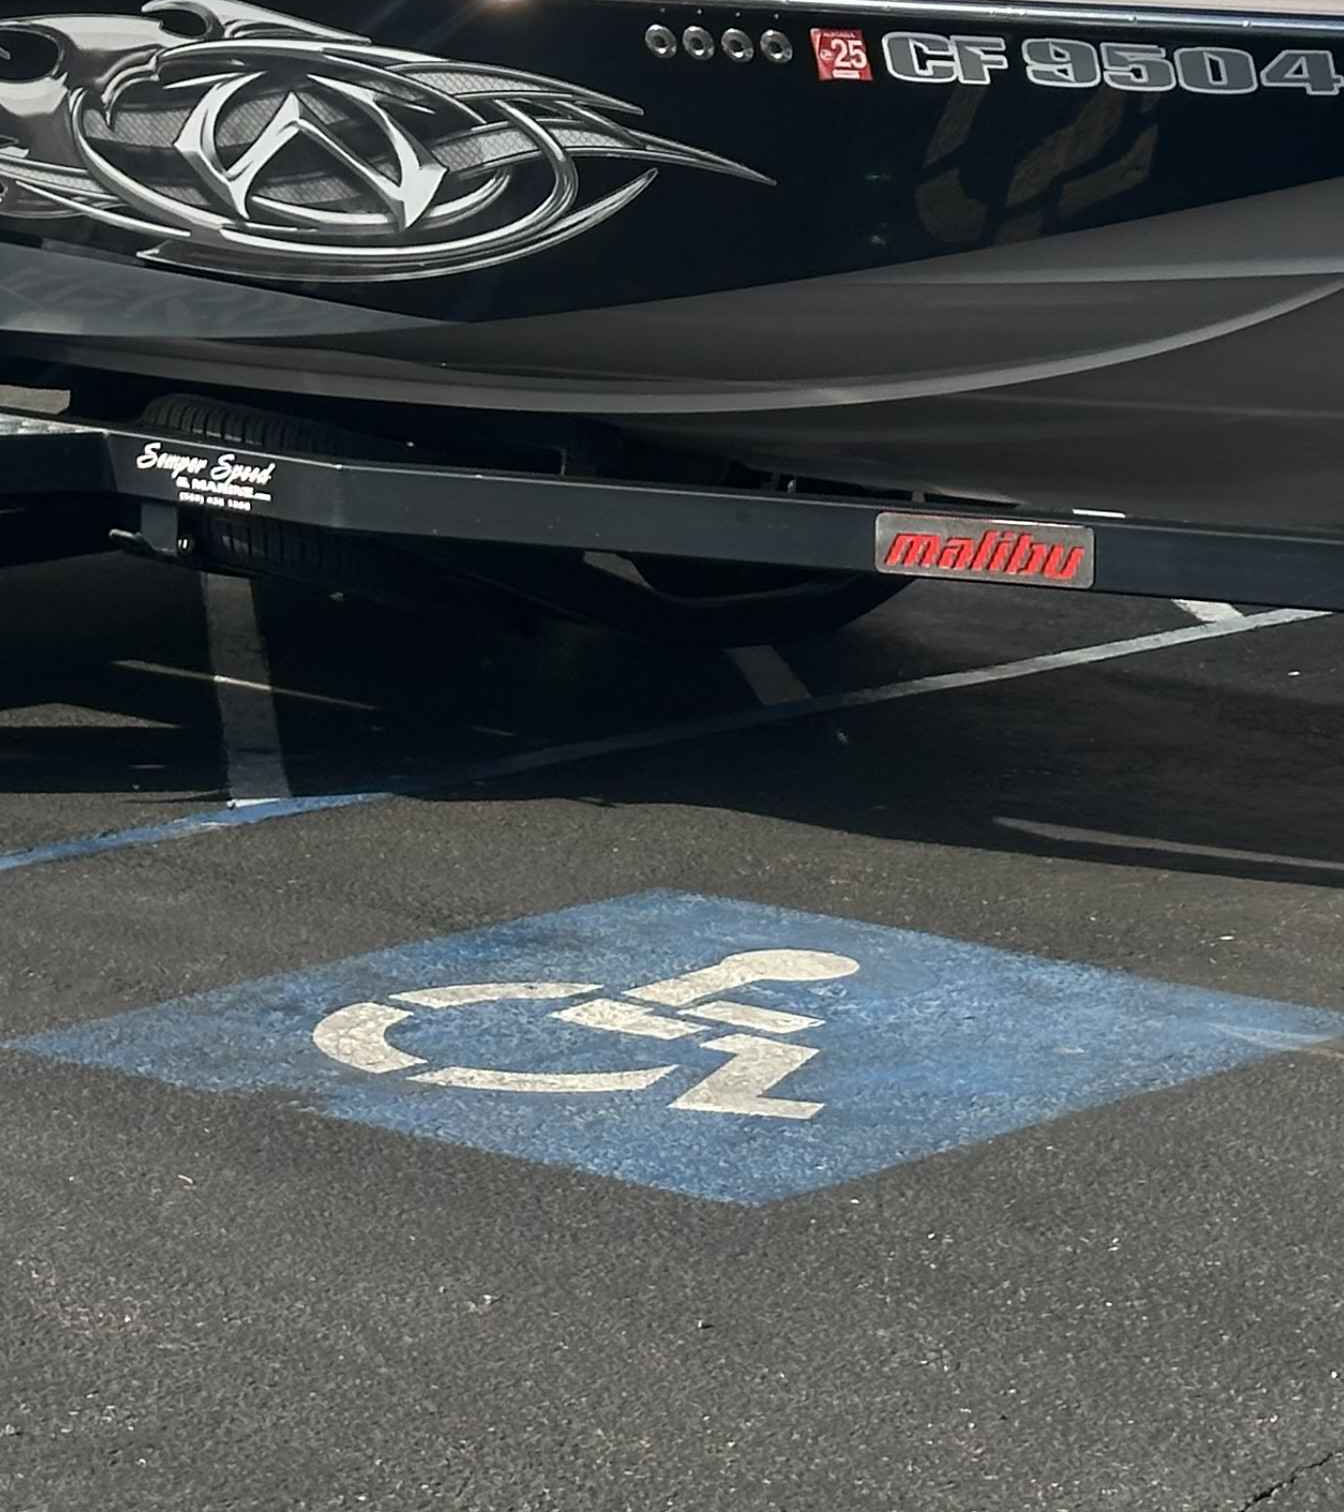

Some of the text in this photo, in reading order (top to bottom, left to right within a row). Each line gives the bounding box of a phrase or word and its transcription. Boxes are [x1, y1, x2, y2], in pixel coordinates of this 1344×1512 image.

[830, 37, 868, 70] 25
[880, 31, 1009, 85] CF
[884, 529, 1086, 580] malibu
